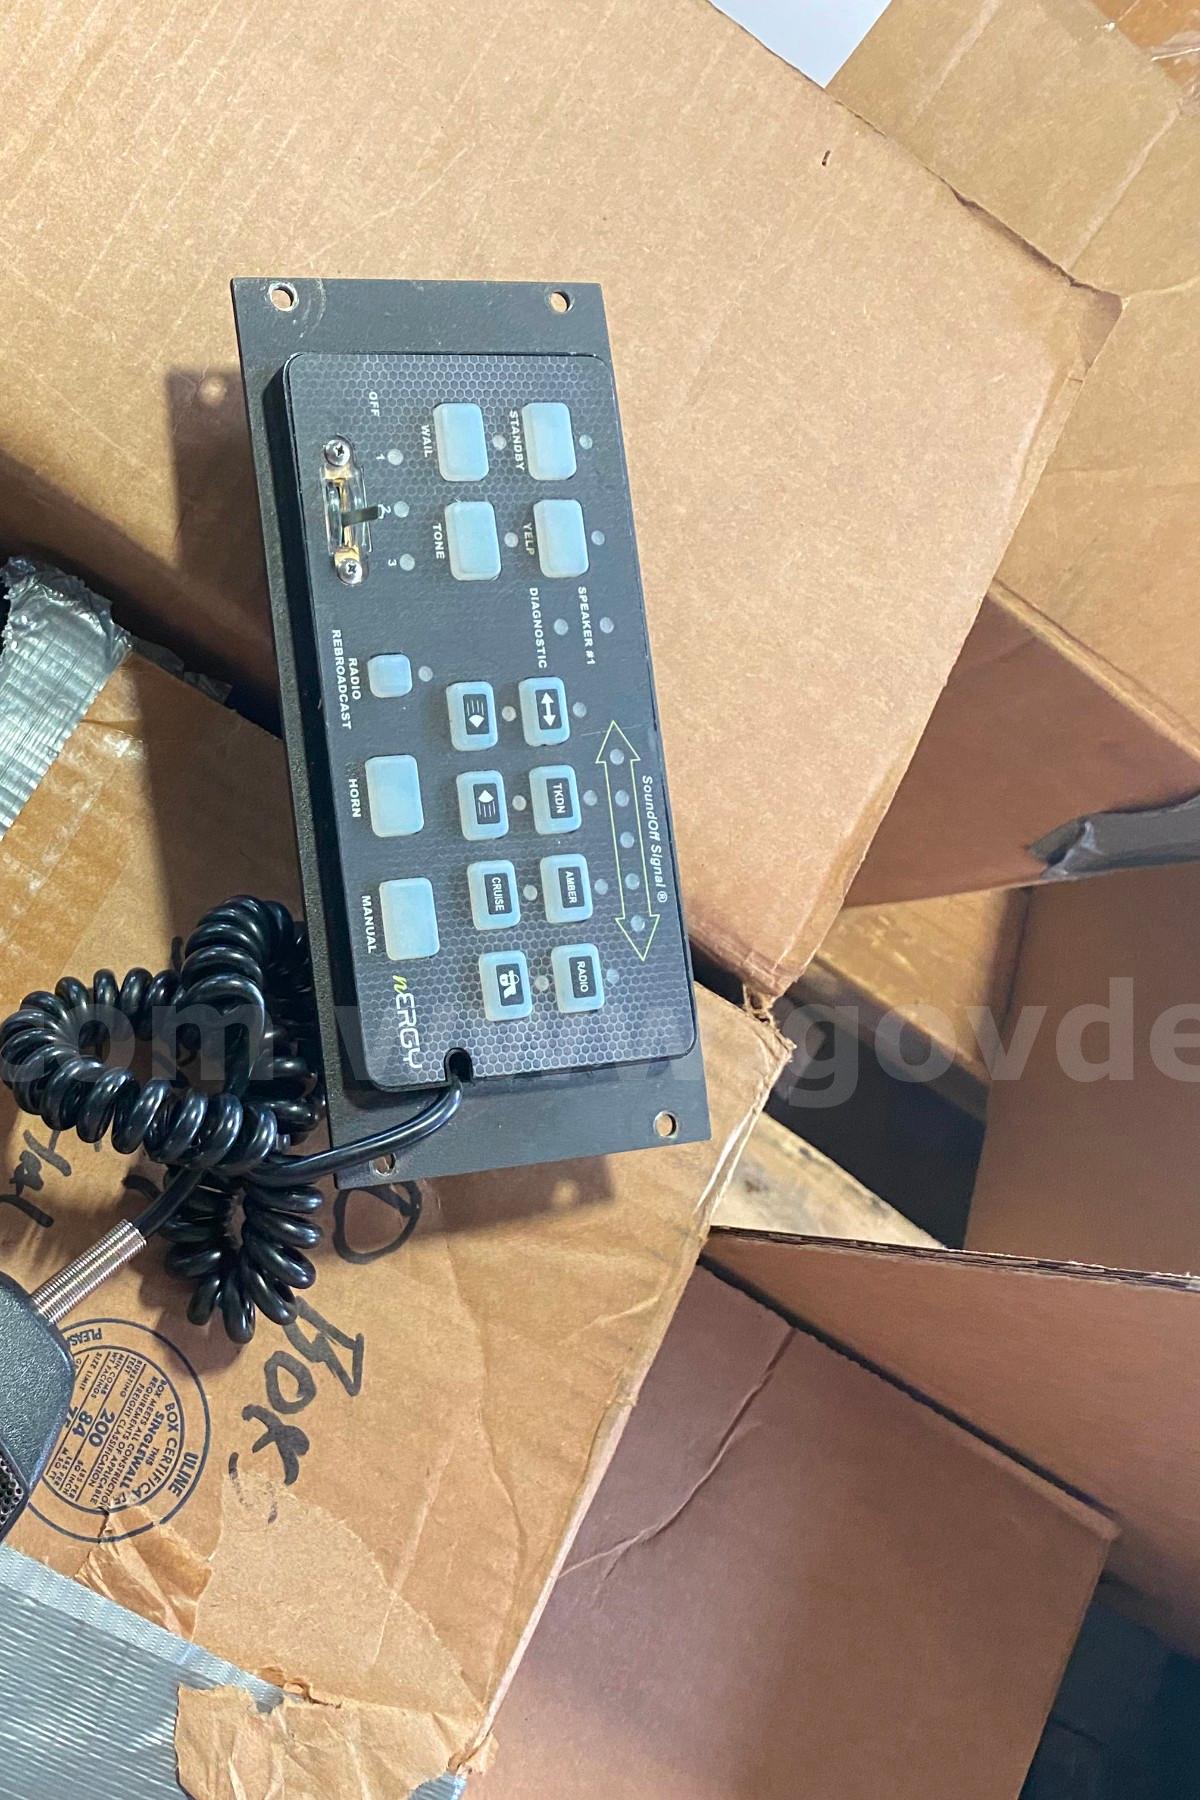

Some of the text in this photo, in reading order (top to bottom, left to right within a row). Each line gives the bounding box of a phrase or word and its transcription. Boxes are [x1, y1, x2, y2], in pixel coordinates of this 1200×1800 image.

[367, 391, 381, 418] OFF
[420, 424, 434, 458] WAIL
[508, 410, 526, 472] STANDBY
[432, 522, 446, 560] TONE
[522, 522, 536, 556] YELP
[388, 558, 398, 567] 3
[528, 587, 548, 669] DIAGNOSTIC
[577, 586, 596, 665] SPEAKER #1
[331, 629, 352, 730] REBROADCAST
[347, 657, 362, 701] RADIO
[347, 777, 362, 819] HORN
[551, 782, 566, 815] TKDN
[641, 775, 662, 849] SoundOff
[564, 870, 578, 904] AMBER
[649, 848, 668, 890] Signal
[490, 876, 506, 912] CRUISE
[360, 895, 377, 955] MANUAL
[574, 960, 590, 993] RADIO
[66, 1327, 103, 1346] PLEAS
[80, 1351, 103, 1390] SIZE LIMIT
[90, 1352, 119, 1399] WT FACINGS
[100, 1353, 126, 1395] MIN COMB
[119, 1360, 143, 1398] BURSTING
[125, 1357, 137, 1374] TEST
[71, 1409, 94, 1438] 84
[87, 1408, 116, 1448] 200
[87, 1383, 146, 1488] FREIGHT CLASSIFICATION
[165, 1402, 179, 1433] BOX
[90, 1376, 158, 1504] REQUIREMENTS OF APPLICABLE
[98, 1379, 168, 1510] BOX MEETS ALL CONSTRUCTION
[119, 1411, 165, 1489] SINGLEWALL
[145, 1447, 160, 1466] THIS
[62, 1473, 77, 1496] INCH
[169, 1451, 199, 1498] ULINE
